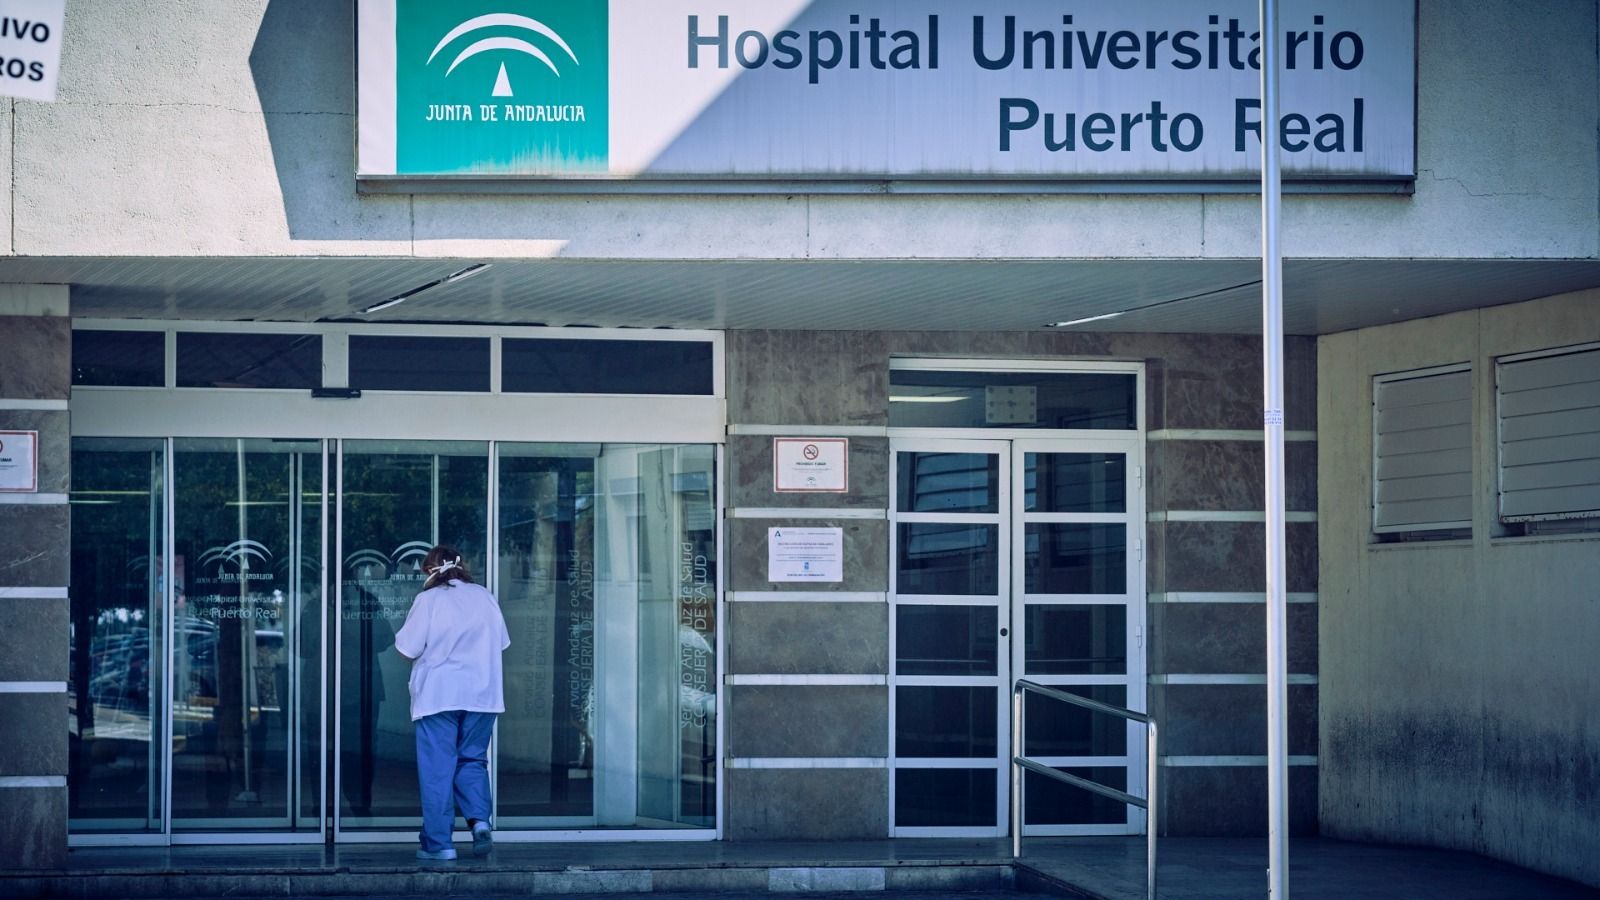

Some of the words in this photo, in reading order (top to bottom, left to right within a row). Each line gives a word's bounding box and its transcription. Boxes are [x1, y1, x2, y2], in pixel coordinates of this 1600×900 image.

[687, 14, 939, 84] Hospital
[0, 56, 44, 82] OS
[426, 104, 473, 121] JUNTA
[480, 105, 498, 121] DE
[504, 104, 586, 122] ANDALUCIA
[999, 97, 1203, 153] Puerto
[1235, 97, 1364, 153] Real
[680, 542, 693, 583] Salud
[693, 554, 706, 605] SALUD
[680, 586, 693, 605] de
[211, 607, 252, 619] Puerto
[255, 607, 280, 619] Real
[693, 608, 706, 630] DE
